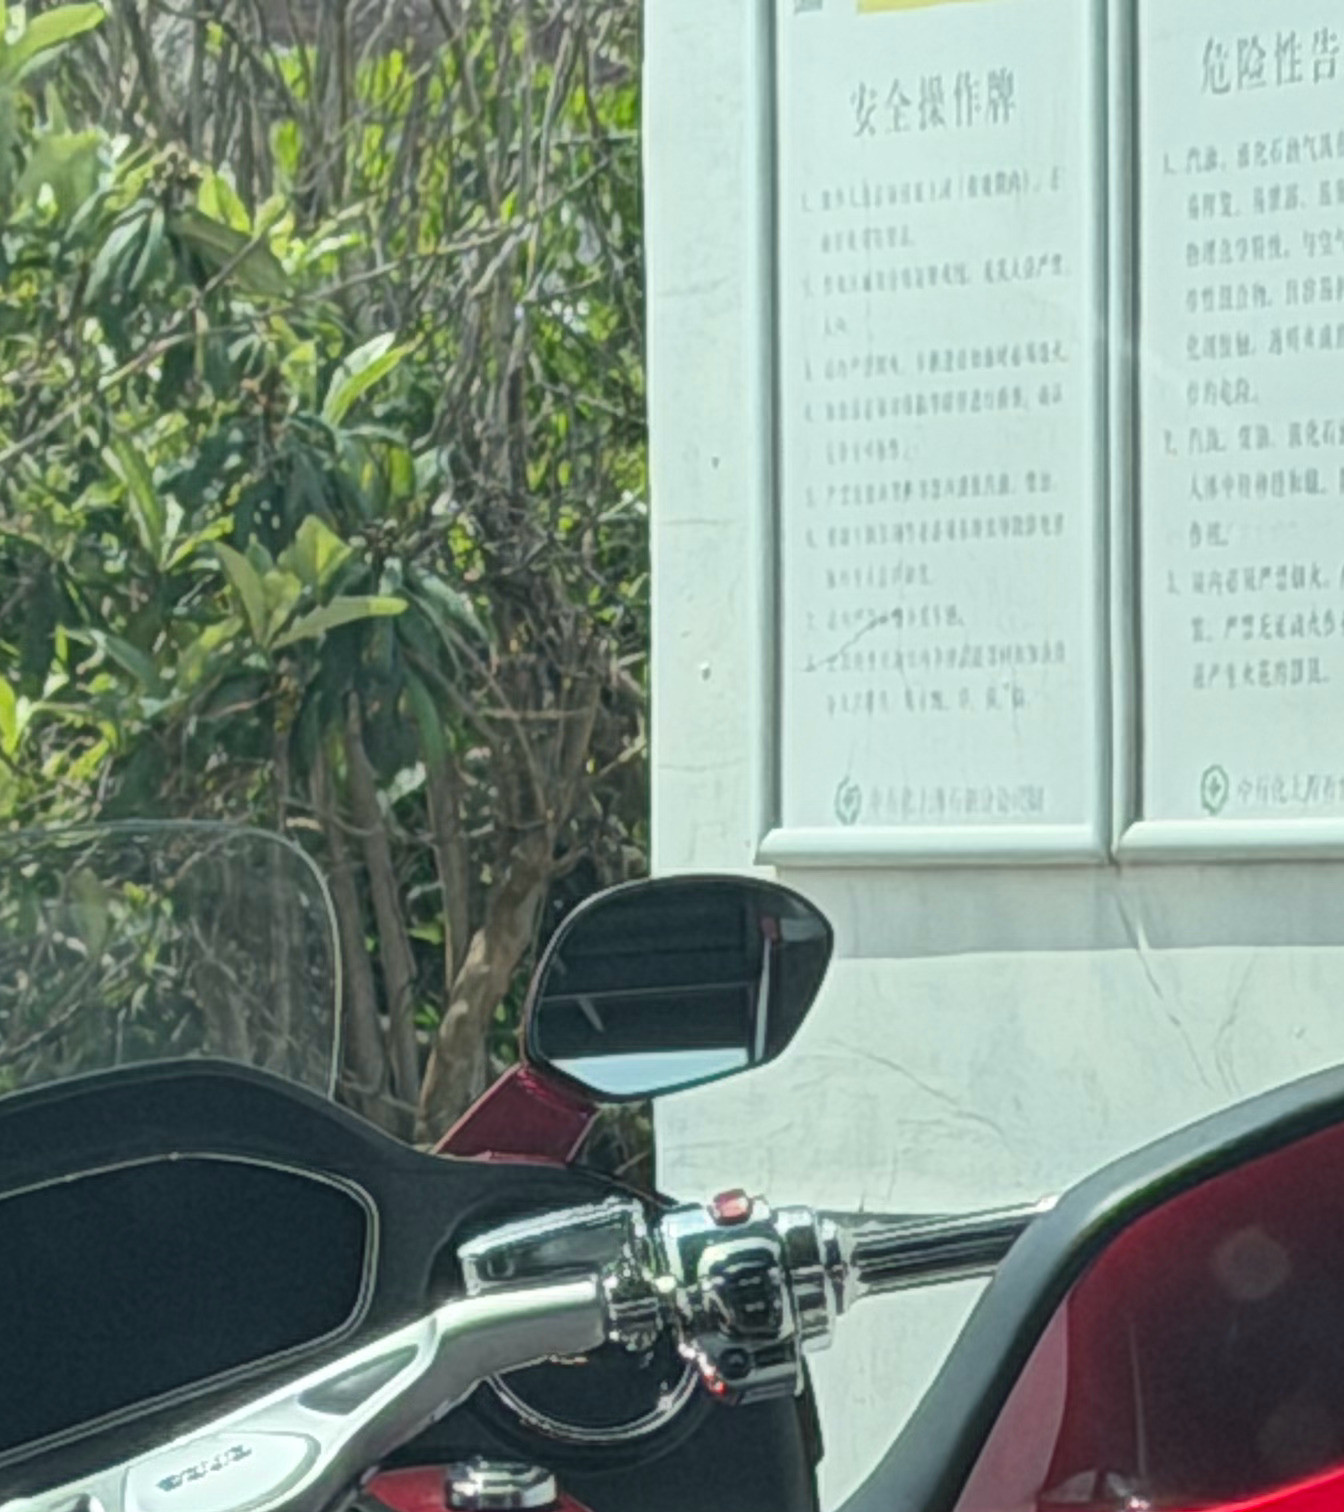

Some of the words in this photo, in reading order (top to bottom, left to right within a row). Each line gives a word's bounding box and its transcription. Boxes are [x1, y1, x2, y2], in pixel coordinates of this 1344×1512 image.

[850, 68, 1016, 138] 安全操作牌
